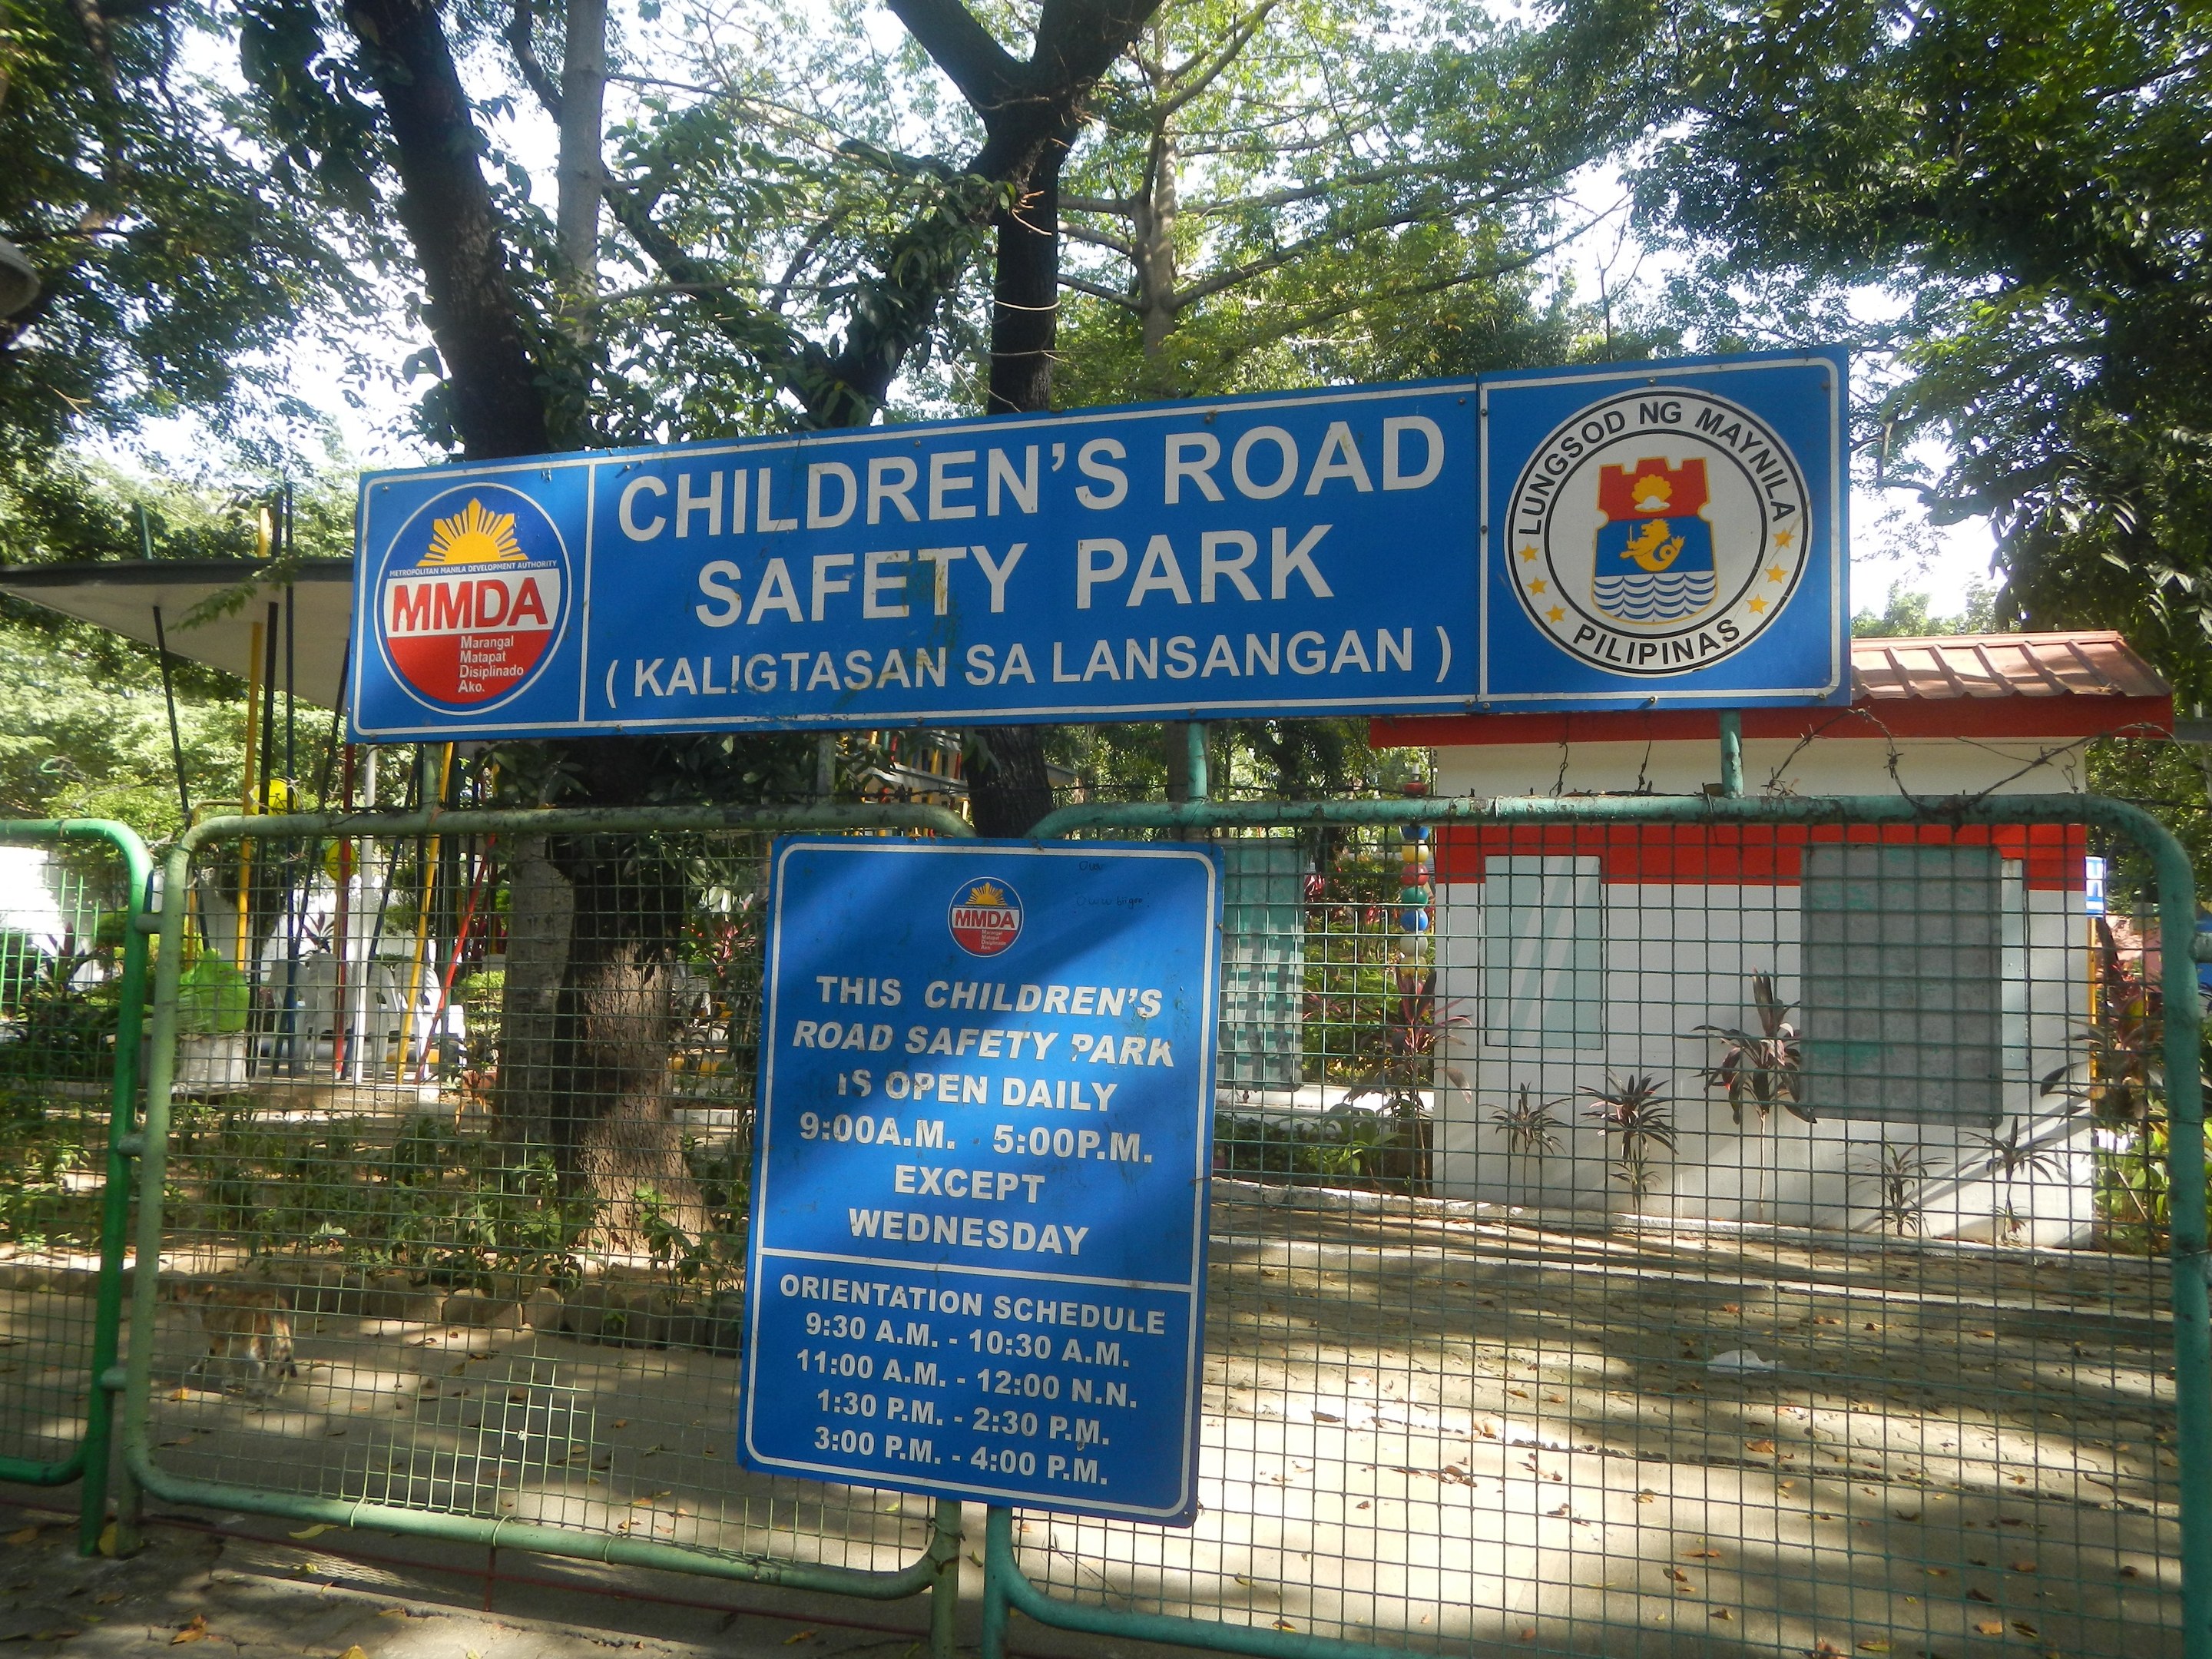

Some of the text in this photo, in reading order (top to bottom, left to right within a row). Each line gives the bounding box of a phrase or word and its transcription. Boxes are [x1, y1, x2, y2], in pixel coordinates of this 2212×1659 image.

[619, 416, 1445, 541] CHILDREN'S ROAD
[1518, 401, 1796, 535] LUNGSOD NG MAYNILA
[389, 559, 558, 577] METROPOLITAN MANILA DEVELOPMENT AUTHORITY
[697, 525, 1333, 627] SAFETY PARK
[392, 577, 548, 632] MMDA
[459, 650, 507, 666] Matapat
[460, 635, 514, 651] Marangal
[635, 647, 945, 696] KALIGTASAN
[965, 644, 1035, 685] SA
[1054, 628, 1412, 682] LANSANGAN
[1572, 618, 1741, 667] PILIPINAS
[458, 679, 485, 694] Ako.
[459, 664, 525, 680] Disiplinado
[955, 909, 1016, 929] MMDA
[817, 977, 1161, 1018] THIS CHILDREN'S
[793, 1022, 1173, 1067] ROAD SAFETY PARK
[840, 1070, 1116, 1111] IS OPEN DAILY
[801, 1113, 1151, 1162] 9:00A.M. 5:00P.M.
[896, 1165, 1045, 1203] EXCEPT
[849, 1208, 1089, 1255] WEDNESDAY
[780, 1274, 1165, 1334] ORIENTATION SCHEDULE
[806, 1313, 865, 1339] 9:30
[876, 1320, 937, 1347] A.M.
[970, 1330, 1051, 1358] 10:30
[1062, 1339, 1129, 1367] A.M.
[798, 1349, 873, 1378] 11:00
[883, 1359, 945, 1386] A.M.
[978, 1369, 1058, 1399] 12:00
[1073, 1379, 1136, 1407] N.N.
[819, 1389, 876, 1416] 1:30
[888, 1398, 942, 1425] P.M.
[973, 1408, 1037, 1435] 2:30
[1050, 1416, 1108, 1444] P.M.
[815, 1427, 874, 1455] 3:00
[886, 1435, 940, 1463] P.M.
[971, 1447, 1035, 1475] 4:00
[1048, 1455, 1107, 1484] P.M.
